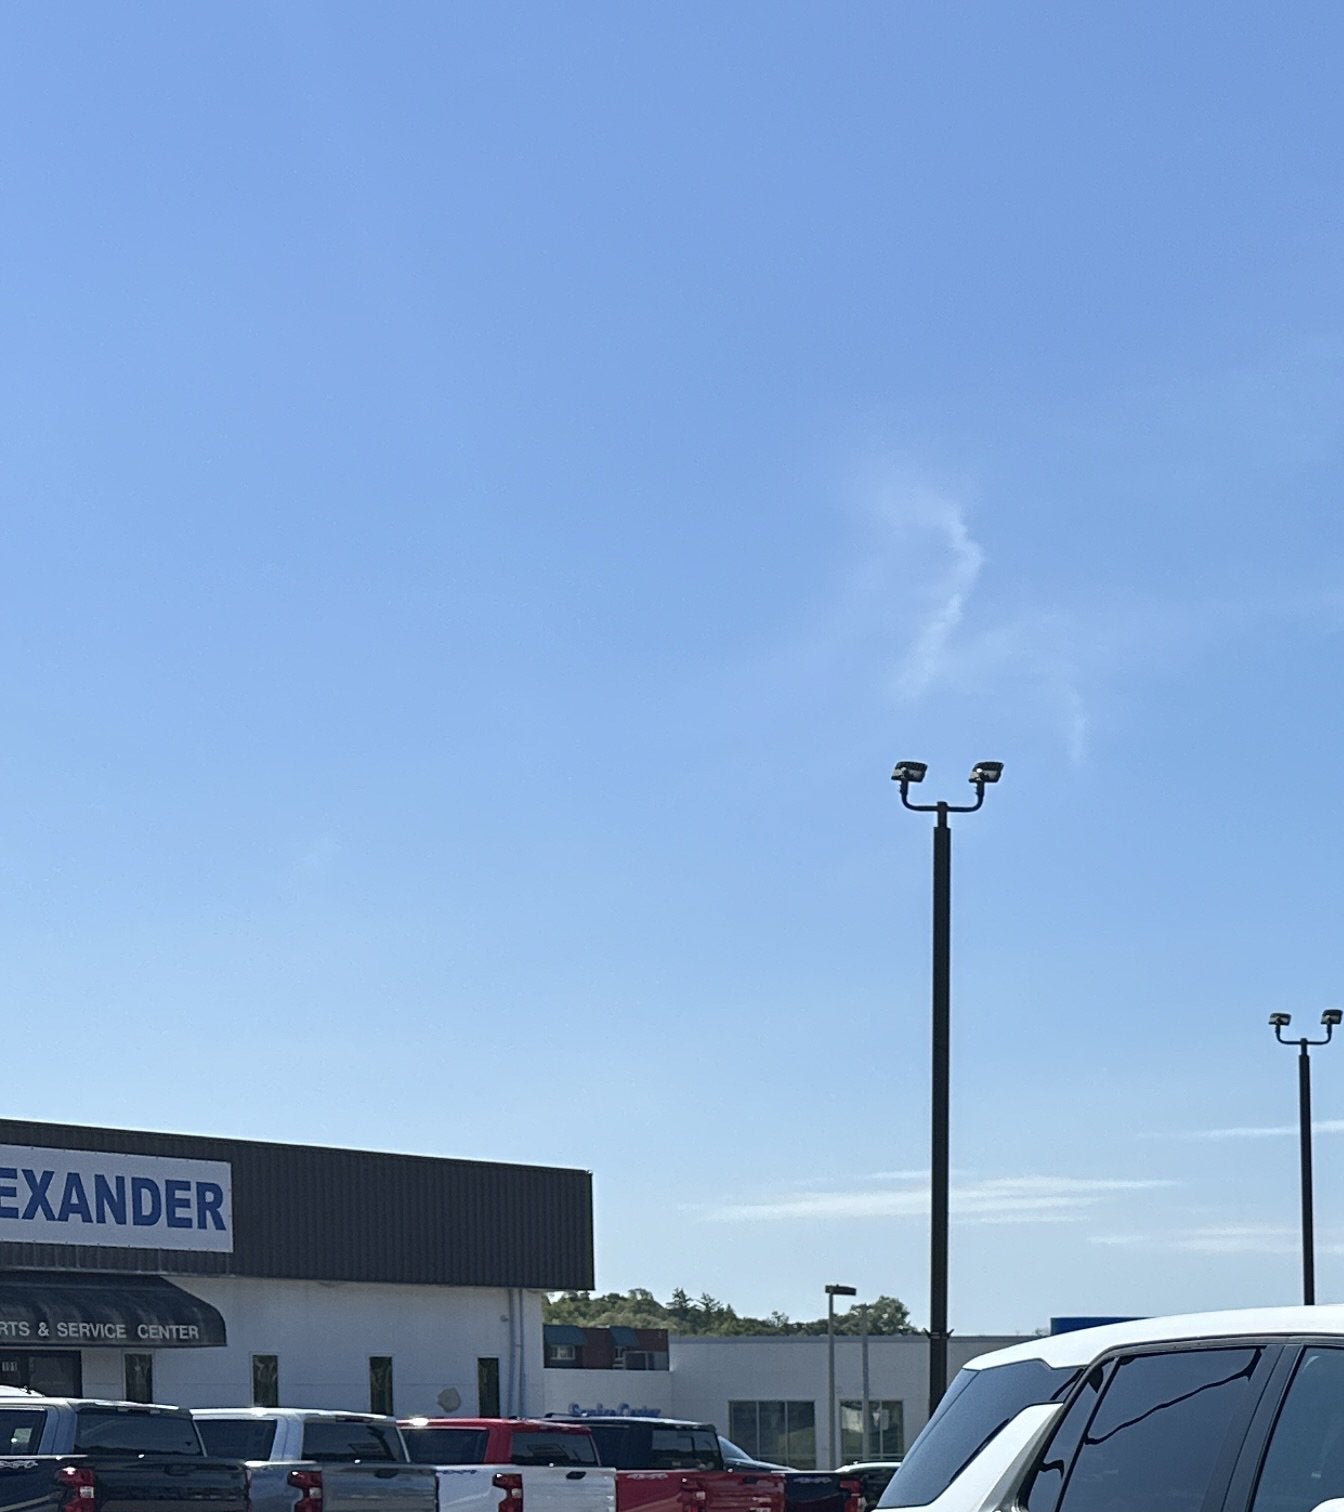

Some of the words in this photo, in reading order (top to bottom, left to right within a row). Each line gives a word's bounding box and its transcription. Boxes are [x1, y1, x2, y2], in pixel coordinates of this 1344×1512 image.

[37, 1321, 50, 1337] &
[56, 1321, 127, 1339] SERVICE
[137, 1323, 200, 1340] CENTER
